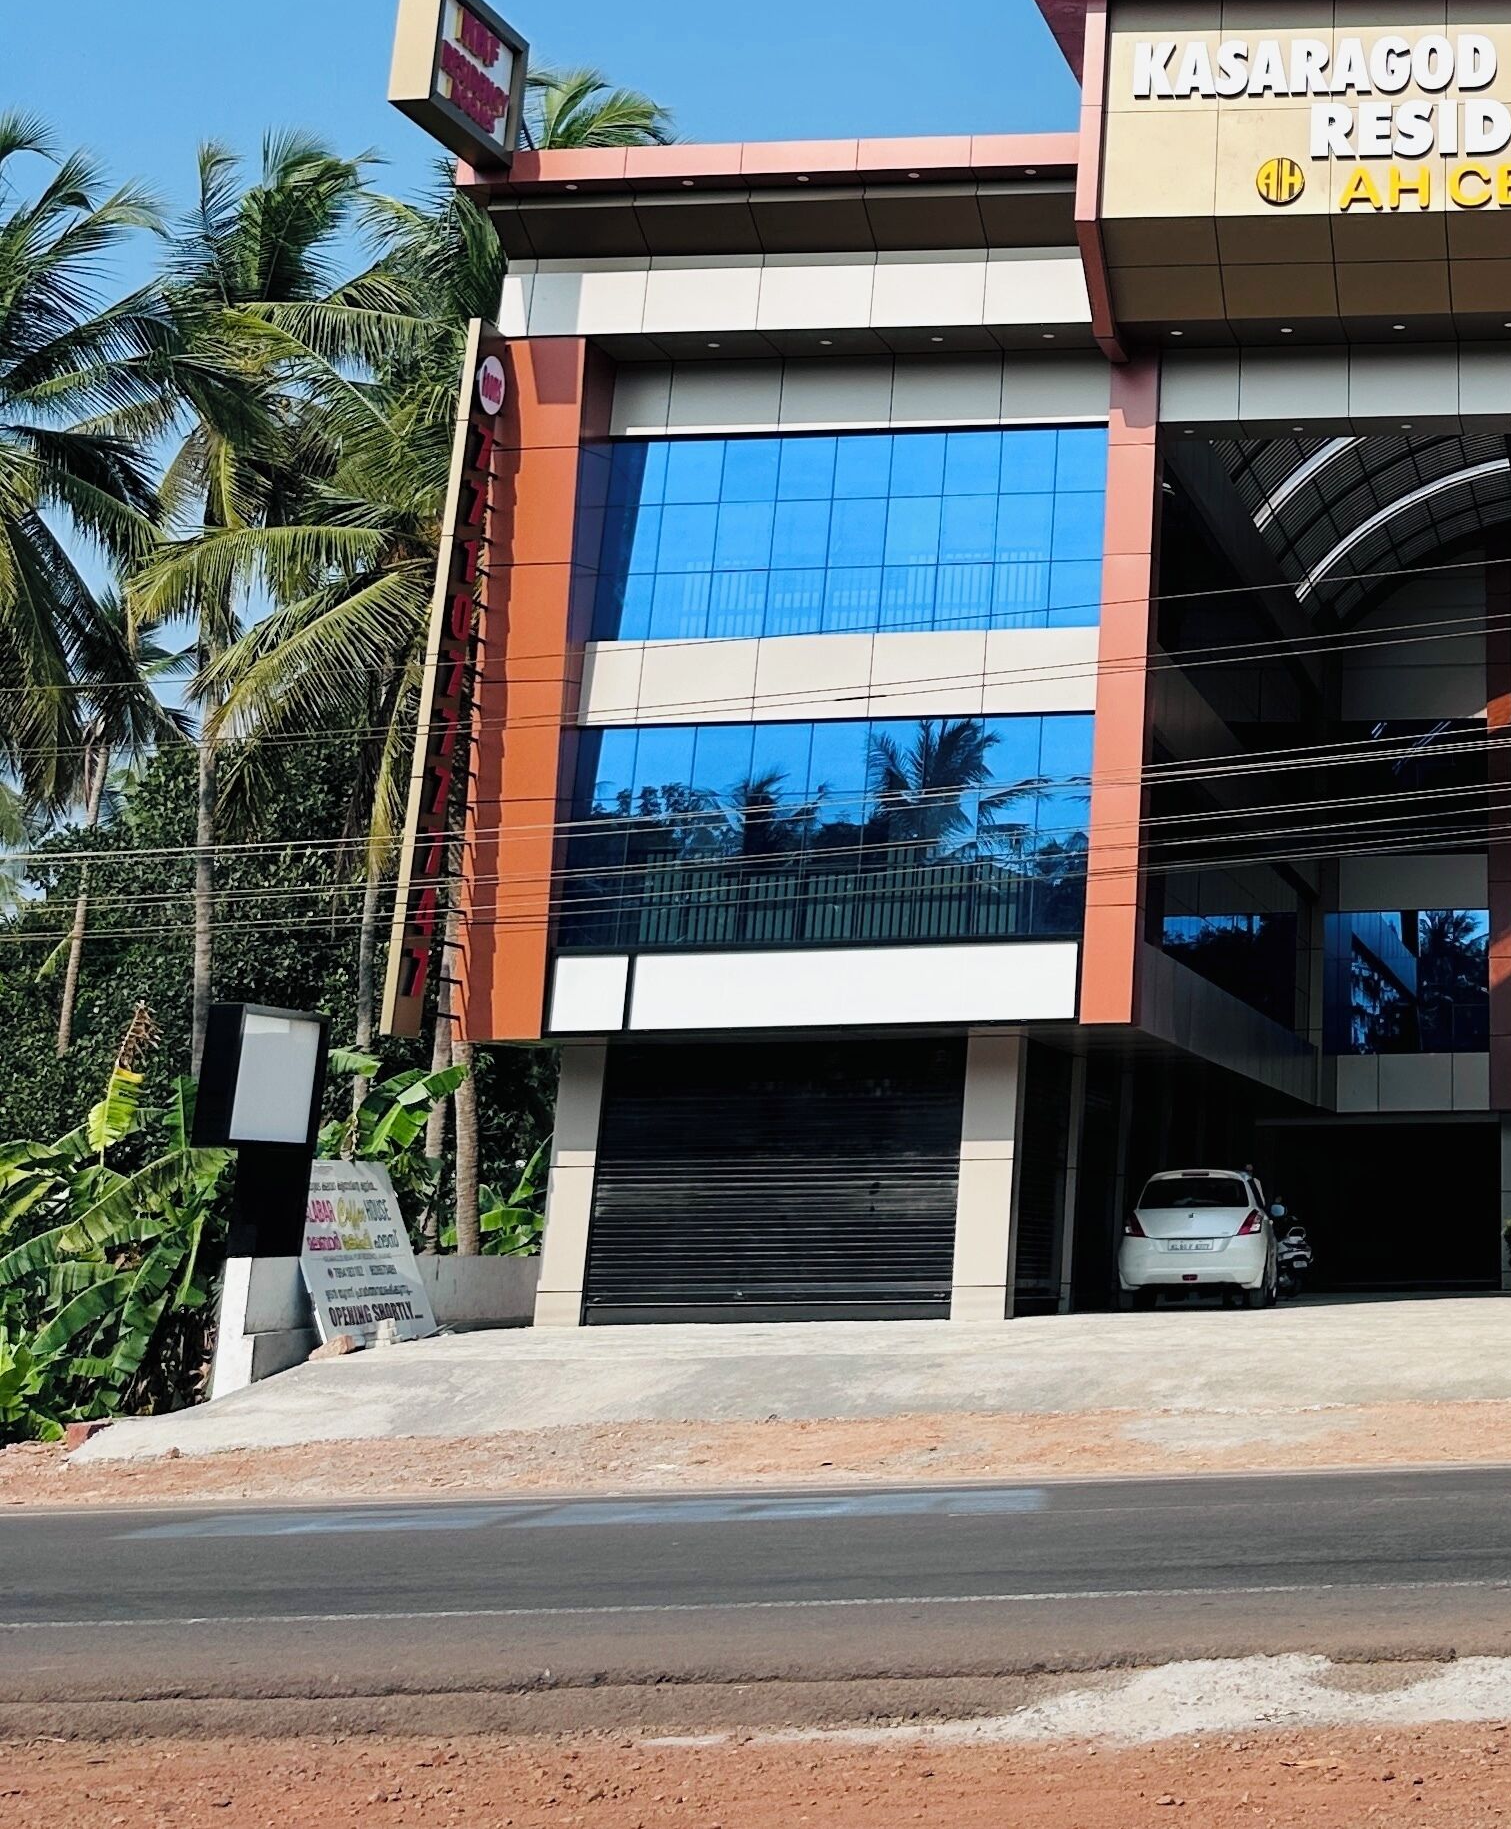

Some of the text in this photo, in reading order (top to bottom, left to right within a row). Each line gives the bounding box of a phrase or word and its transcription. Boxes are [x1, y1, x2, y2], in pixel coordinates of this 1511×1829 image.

[1132, 32, 1497, 100] KASARAGOD
[1340, 166, 1430, 208] AH
[328, 1304, 373, 1327] OPENING
